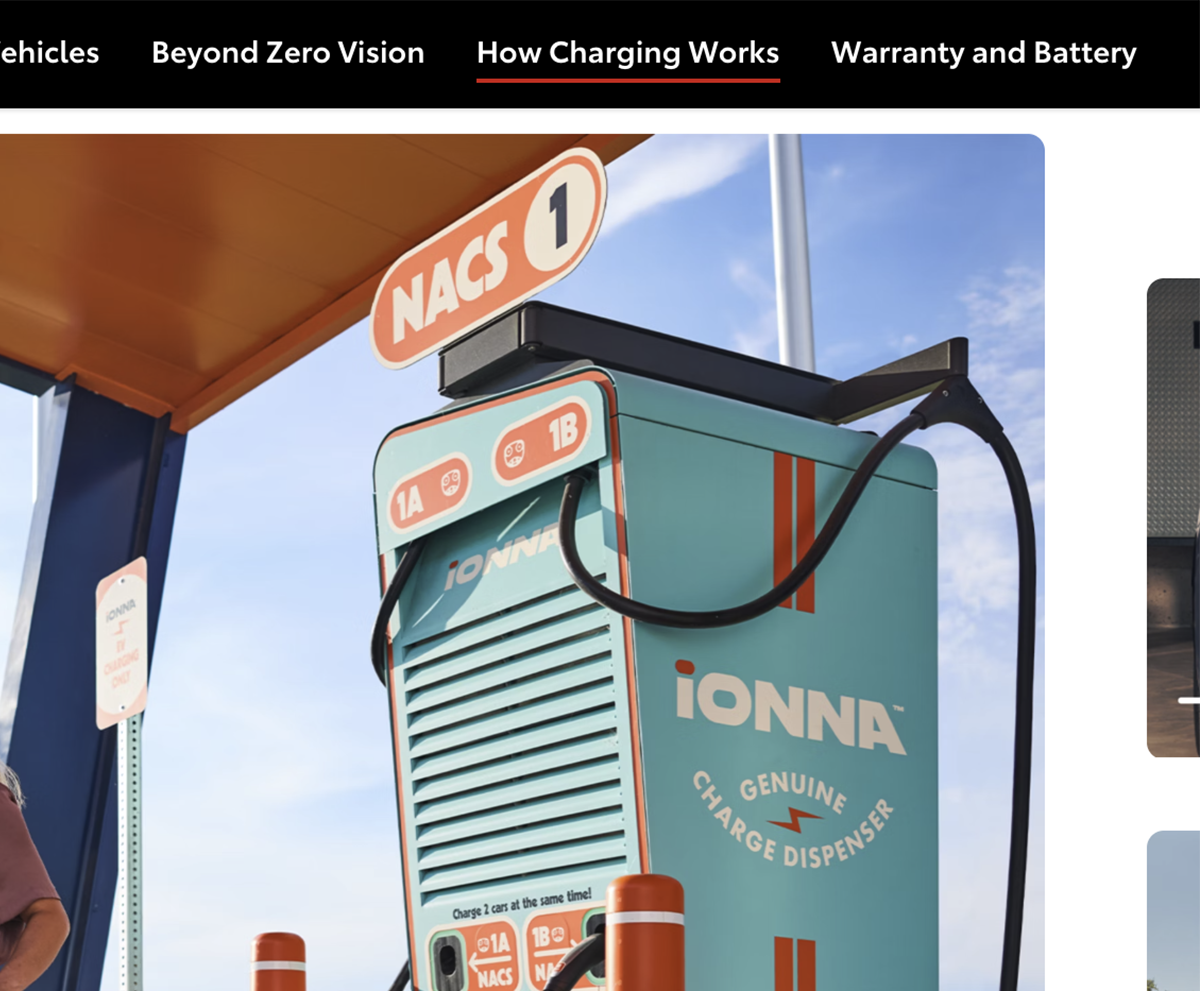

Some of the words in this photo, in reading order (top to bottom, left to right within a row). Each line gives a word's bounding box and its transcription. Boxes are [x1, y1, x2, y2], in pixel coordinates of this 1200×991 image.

[393, 220, 508, 345] NACS
[549, 182, 567, 250] 1
[549, 412, 578, 452] 1B
[396, 485, 424, 521] 1A
[740, 771, 847, 815] GENUINE
[693, 770, 777, 861] CHARGE
[784, 798, 894, 868] DISPENSER
[452, 908, 482, 920] Charge
[484, 904, 489, 915] 2
[491, 903, 508, 914] cars
[511, 899, 520, 911] at
[522, 897, 538, 909] the
[540, 894, 564, 907] same
[567, 887, 592, 904] time!
[490, 932, 511, 953] 1A
[532, 926, 550, 947] 1B
[477, 967, 513, 988] NACS
